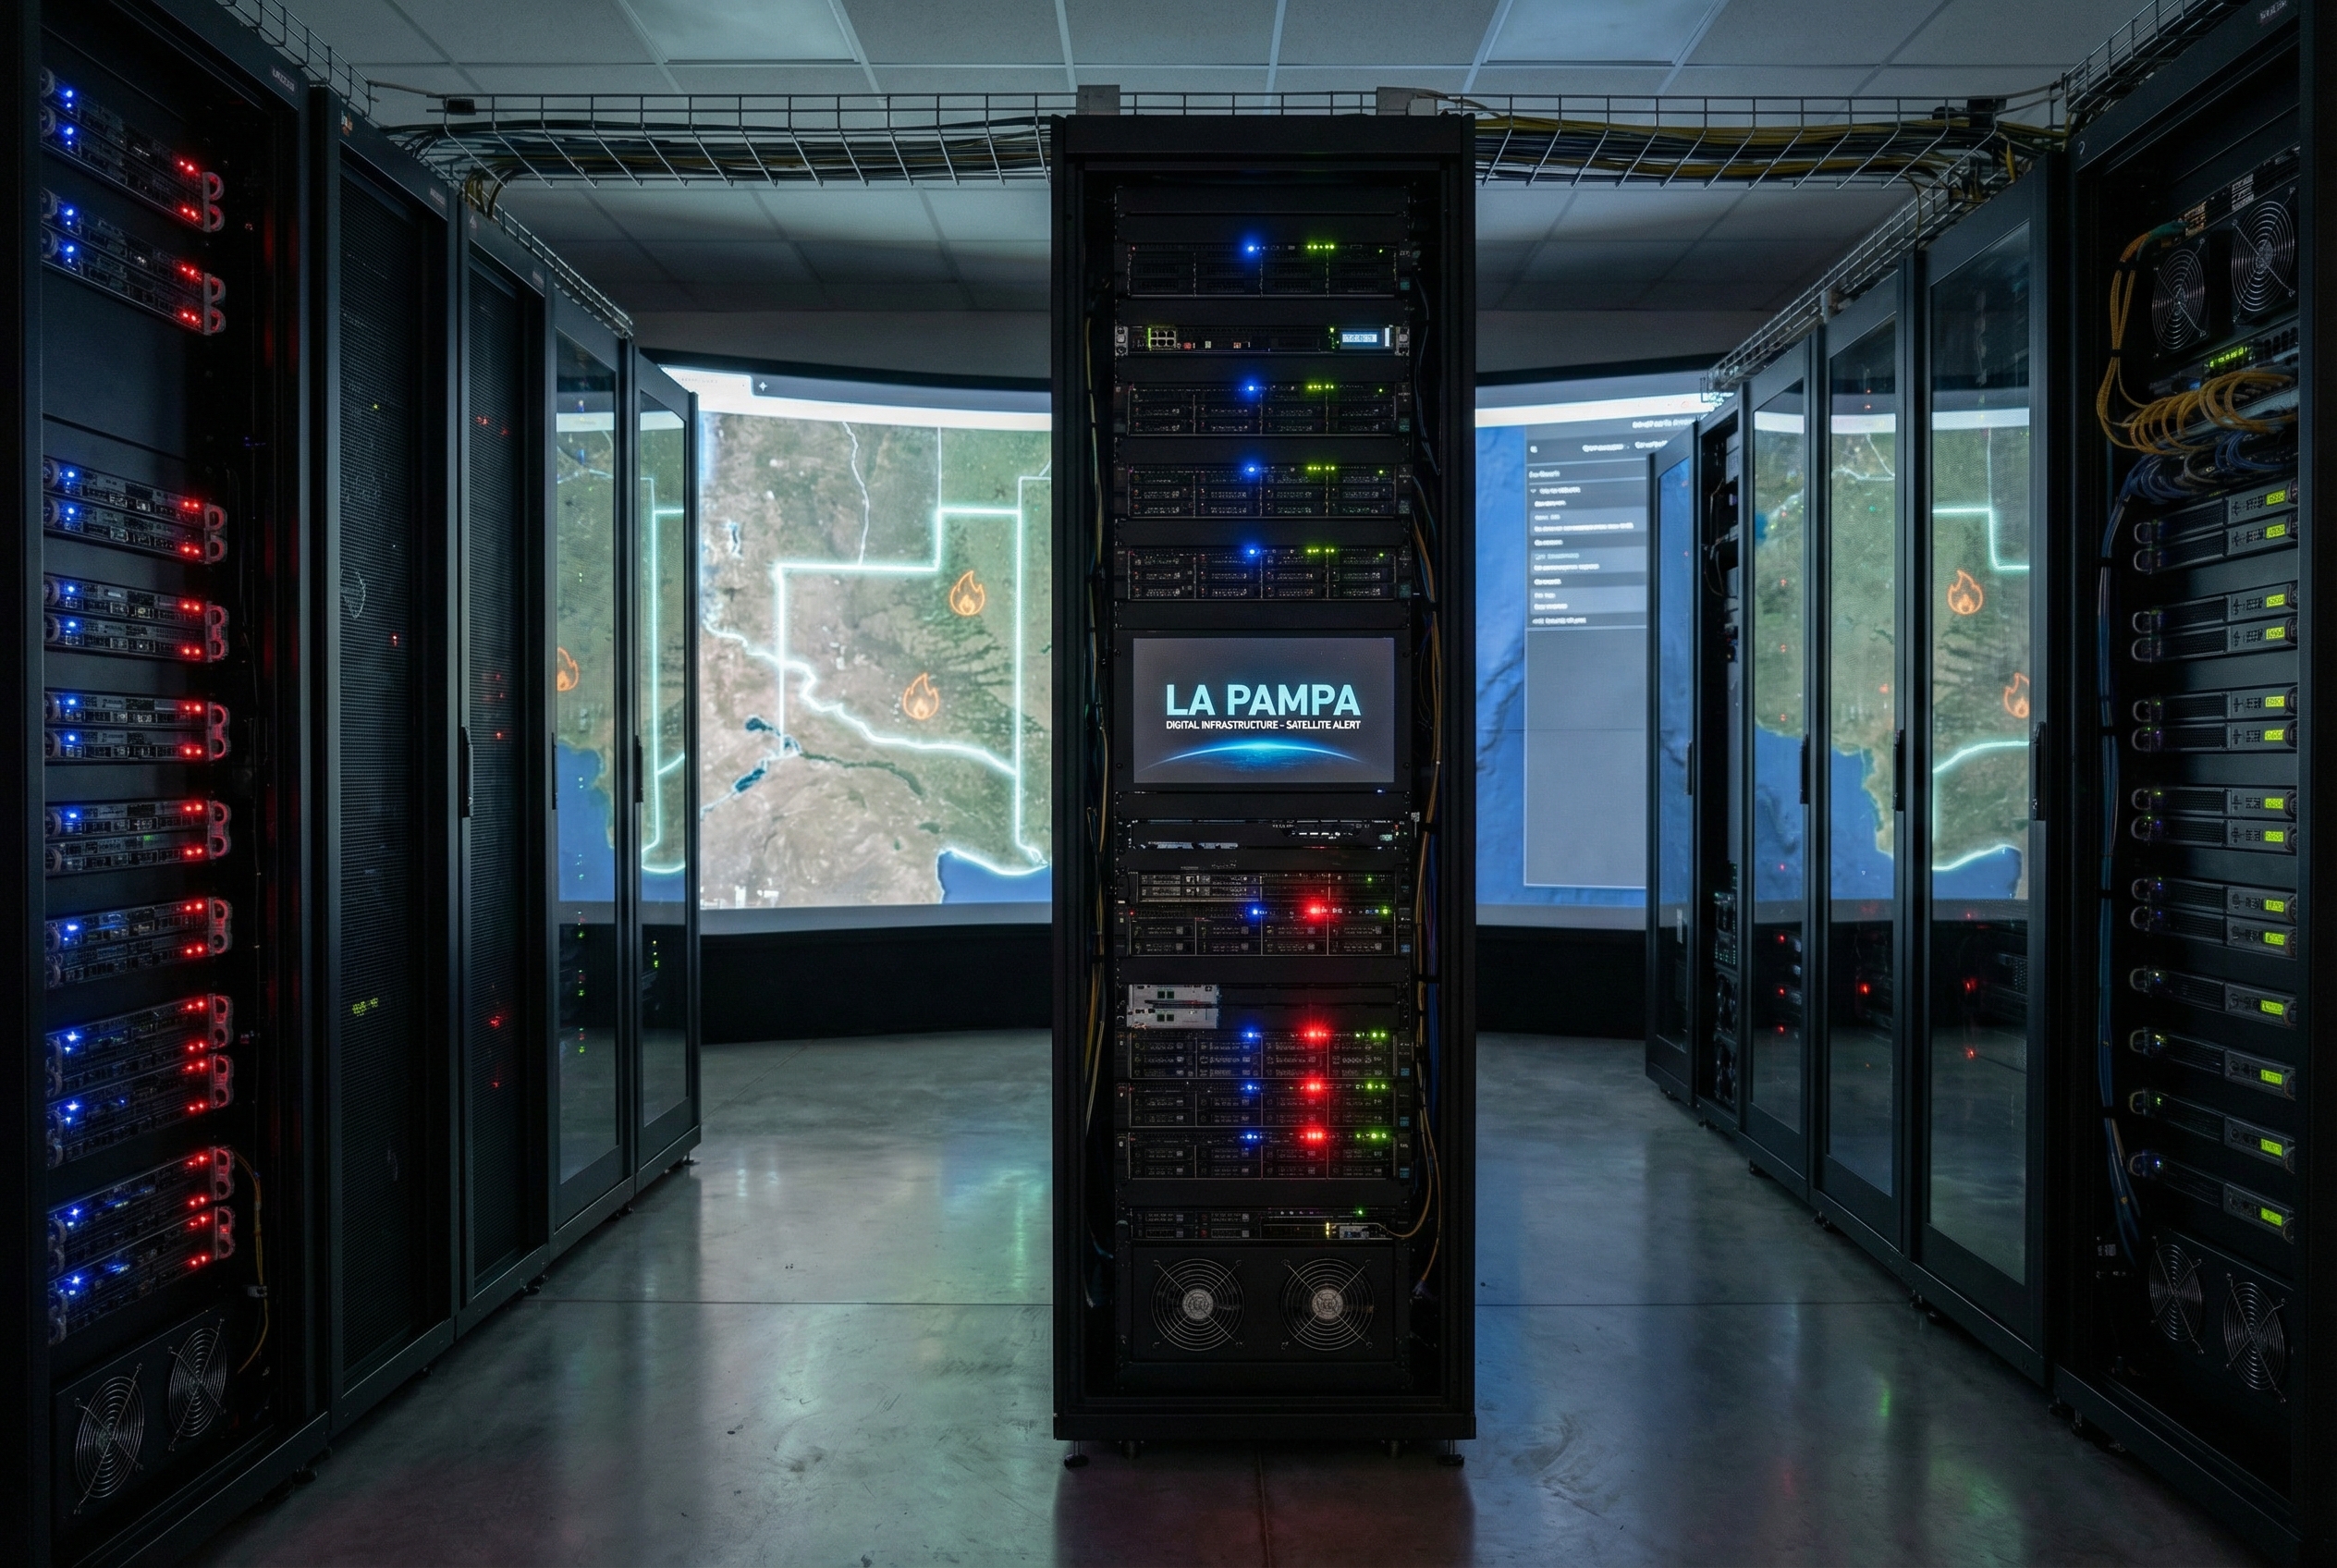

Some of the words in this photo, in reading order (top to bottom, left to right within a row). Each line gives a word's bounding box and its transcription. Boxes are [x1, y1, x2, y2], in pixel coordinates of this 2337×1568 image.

[1167, 684, 1216, 716] LA
[1228, 684, 1362, 716] PAMPA
[1166, 720, 1200, 729] DIGITAL
[1202, 720, 1279, 729] INFRASTRUCTURE
[1286, 720, 1331, 729] SATELLITE
[1332, 720, 1362, 729] ALERT
